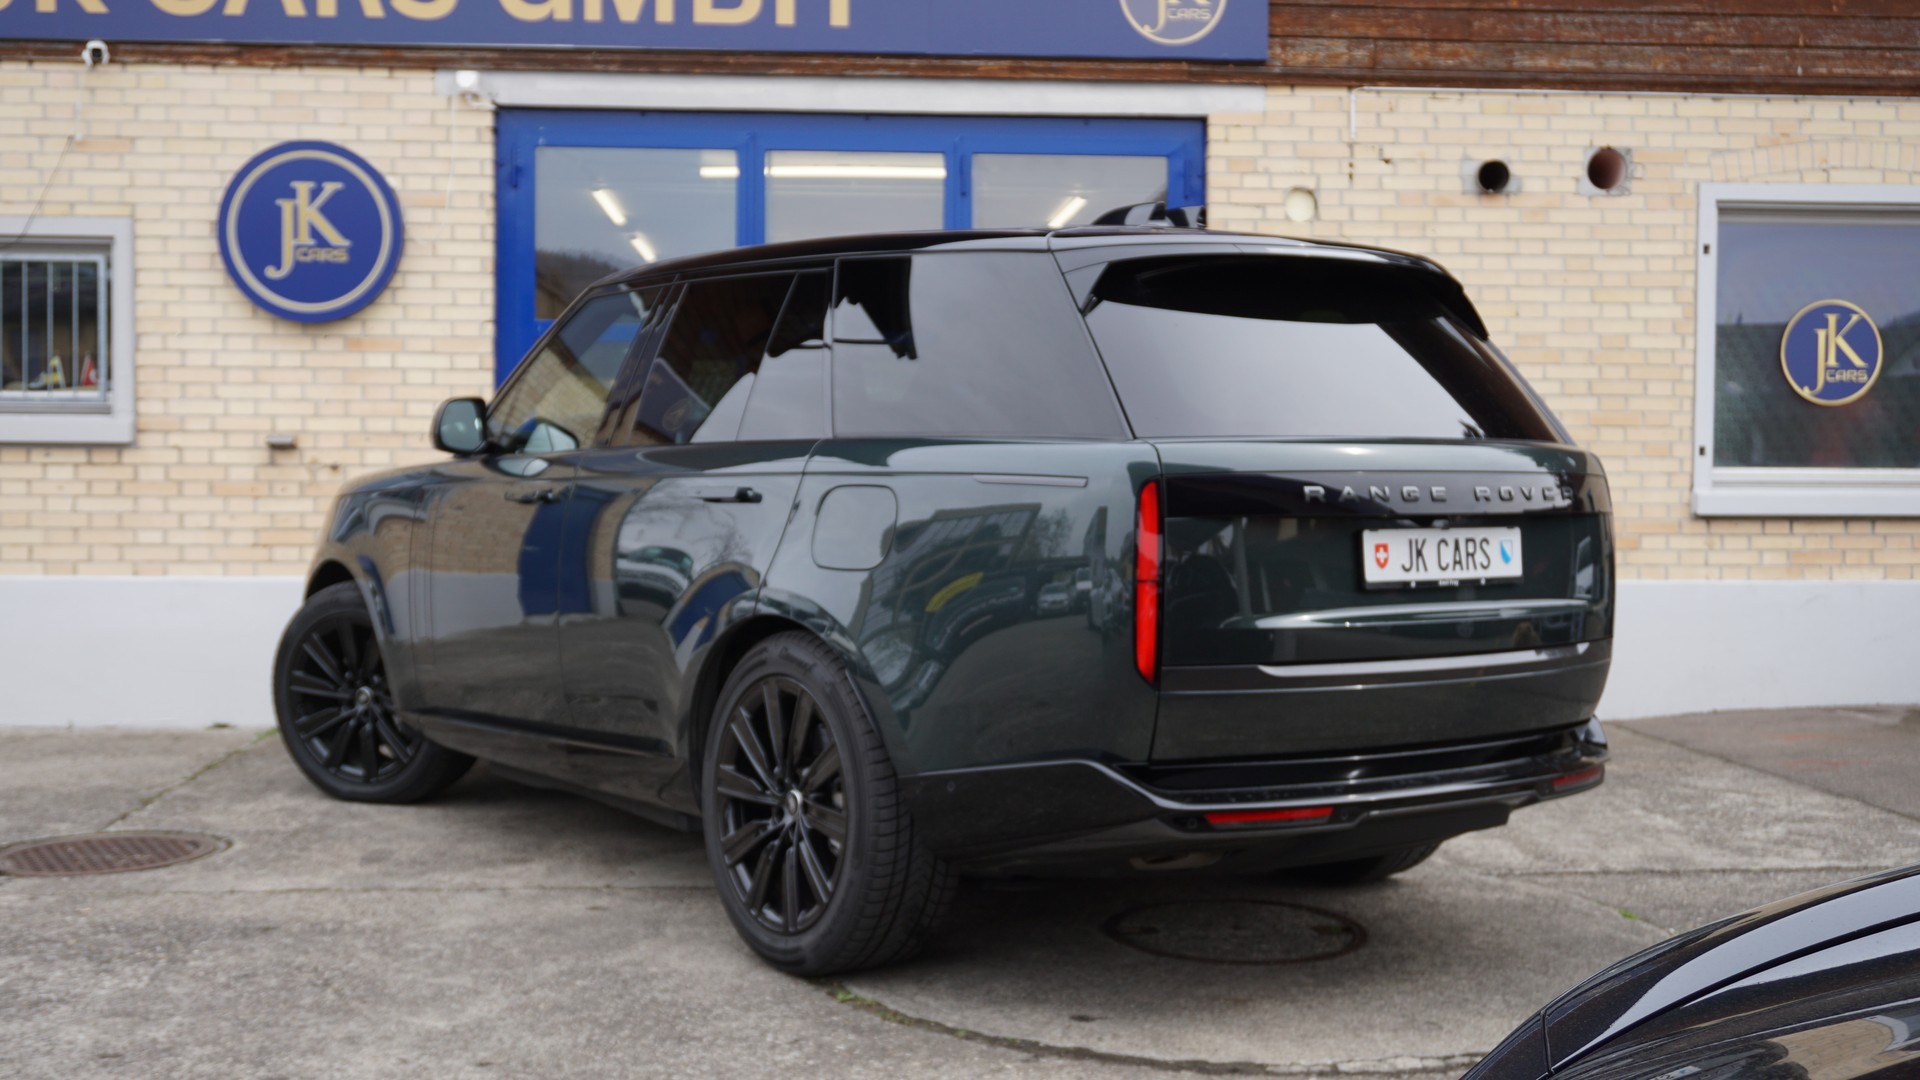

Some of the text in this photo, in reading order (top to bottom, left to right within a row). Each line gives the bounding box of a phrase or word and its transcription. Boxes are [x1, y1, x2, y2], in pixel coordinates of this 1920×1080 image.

[1166, 8, 1212, 20] CARS
[264, 180, 353, 280] JK
[1802, 313, 1869, 397] JK
[1825, 369, 1869, 383] CARS
[1302, 485, 1575, 503] RANGE ROVER
[1401, 537, 1492, 572] JK CARS
